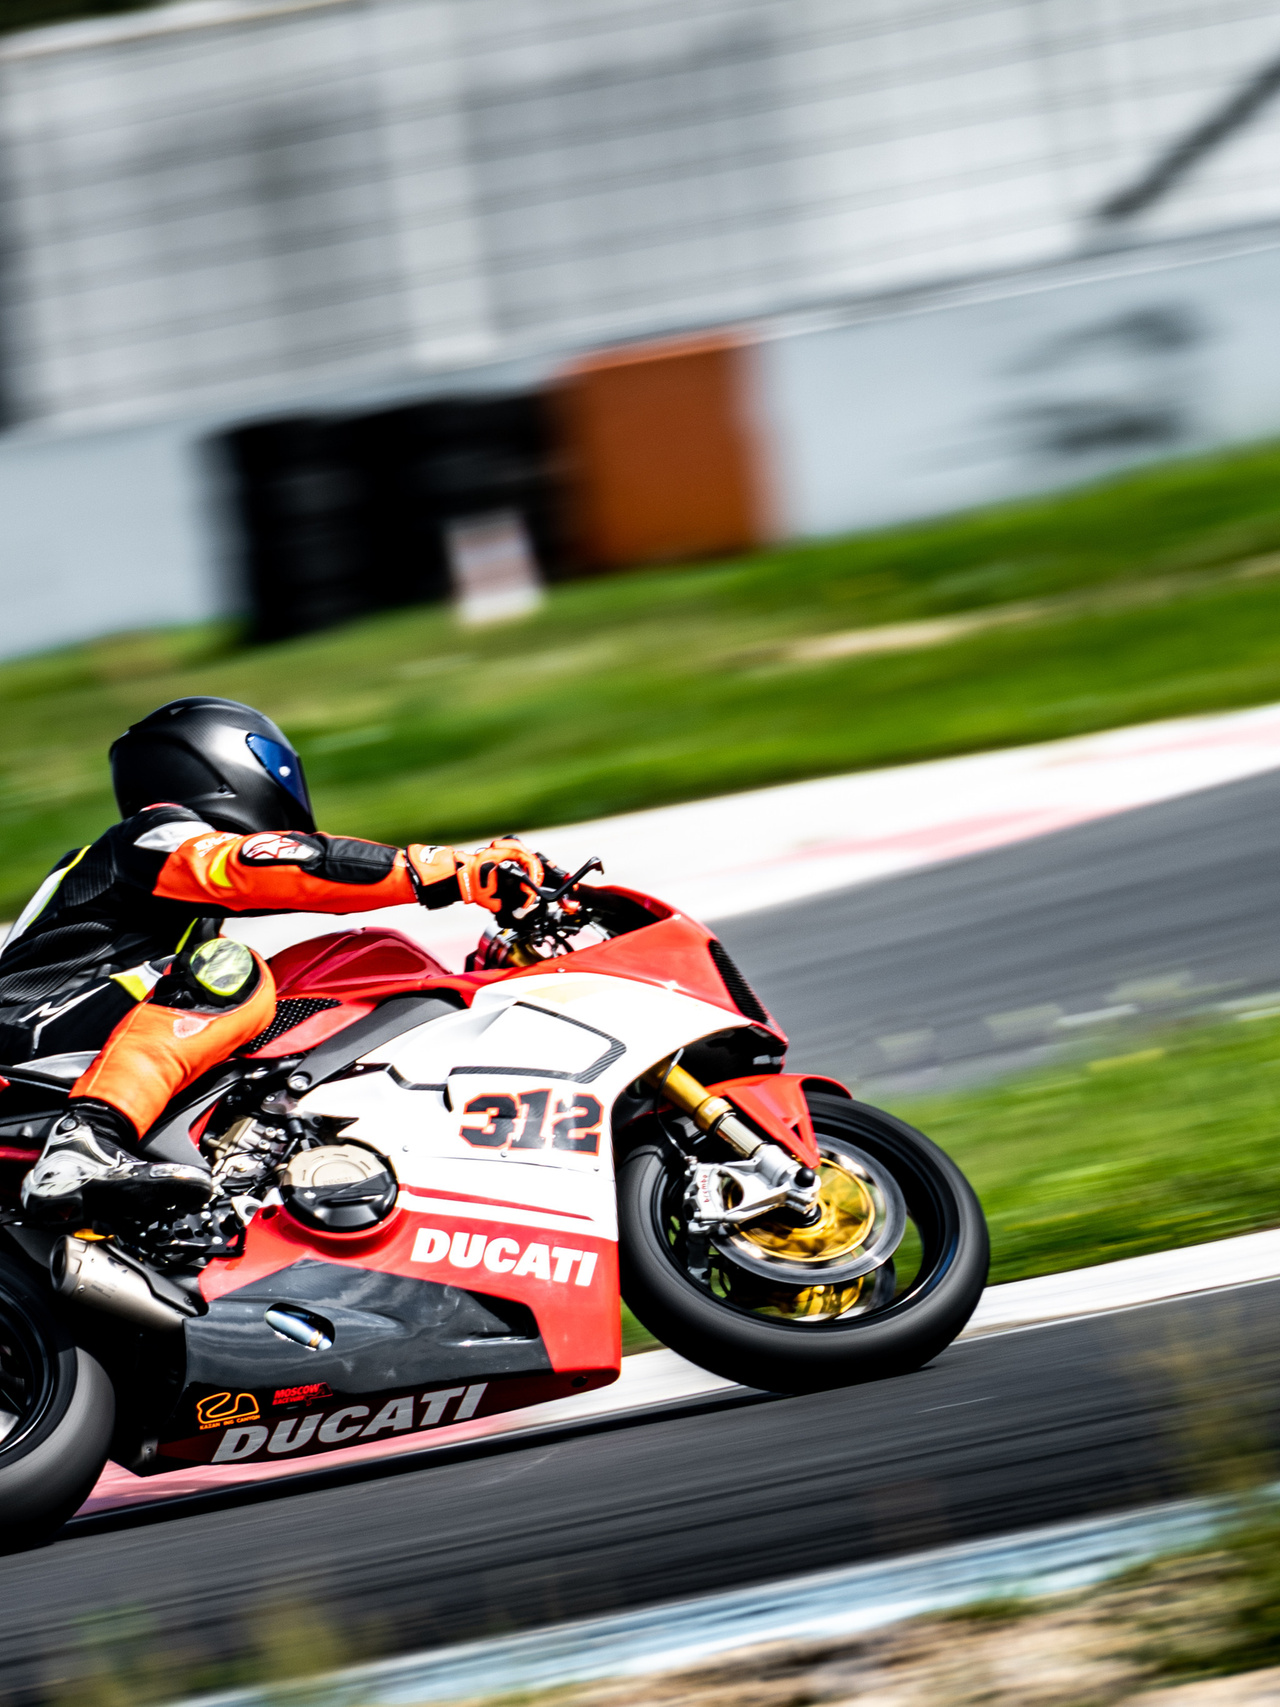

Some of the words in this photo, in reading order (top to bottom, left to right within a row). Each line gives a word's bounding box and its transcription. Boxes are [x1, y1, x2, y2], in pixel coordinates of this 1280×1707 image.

[459, 1088, 604, 1157] 312
[410, 1227, 598, 1287] DUCATI
[211, 1383, 488, 1463] DUCATI
[274, 1383, 321, 1399] MOSCOW
